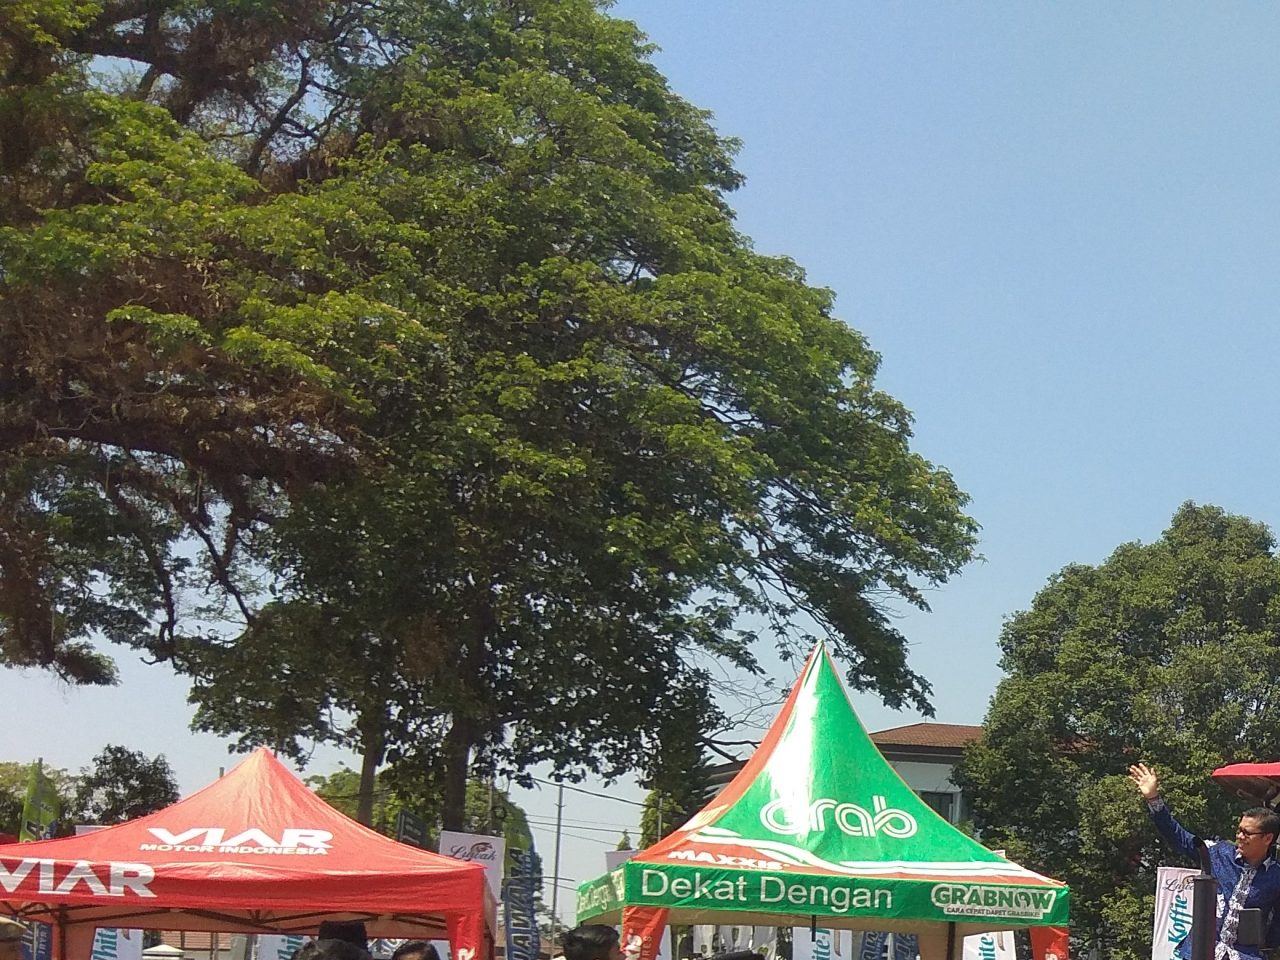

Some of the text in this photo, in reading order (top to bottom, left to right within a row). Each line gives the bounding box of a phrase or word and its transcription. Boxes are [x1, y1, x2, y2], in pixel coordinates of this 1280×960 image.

[760, 795, 918, 838] Grab
[139, 844, 329, 856] MOTOR INDONESIA
[147, 828, 334, 849] VIAR
[667, 850, 783, 870] MAXXIS
[0, 858, 158, 898] VIAR
[641, 869, 748, 902] Dekat
[760, 876, 893, 913] Dengan
[934, 886, 1053, 909] GRABNOW
[1168, 894, 1193, 944] Koffie
